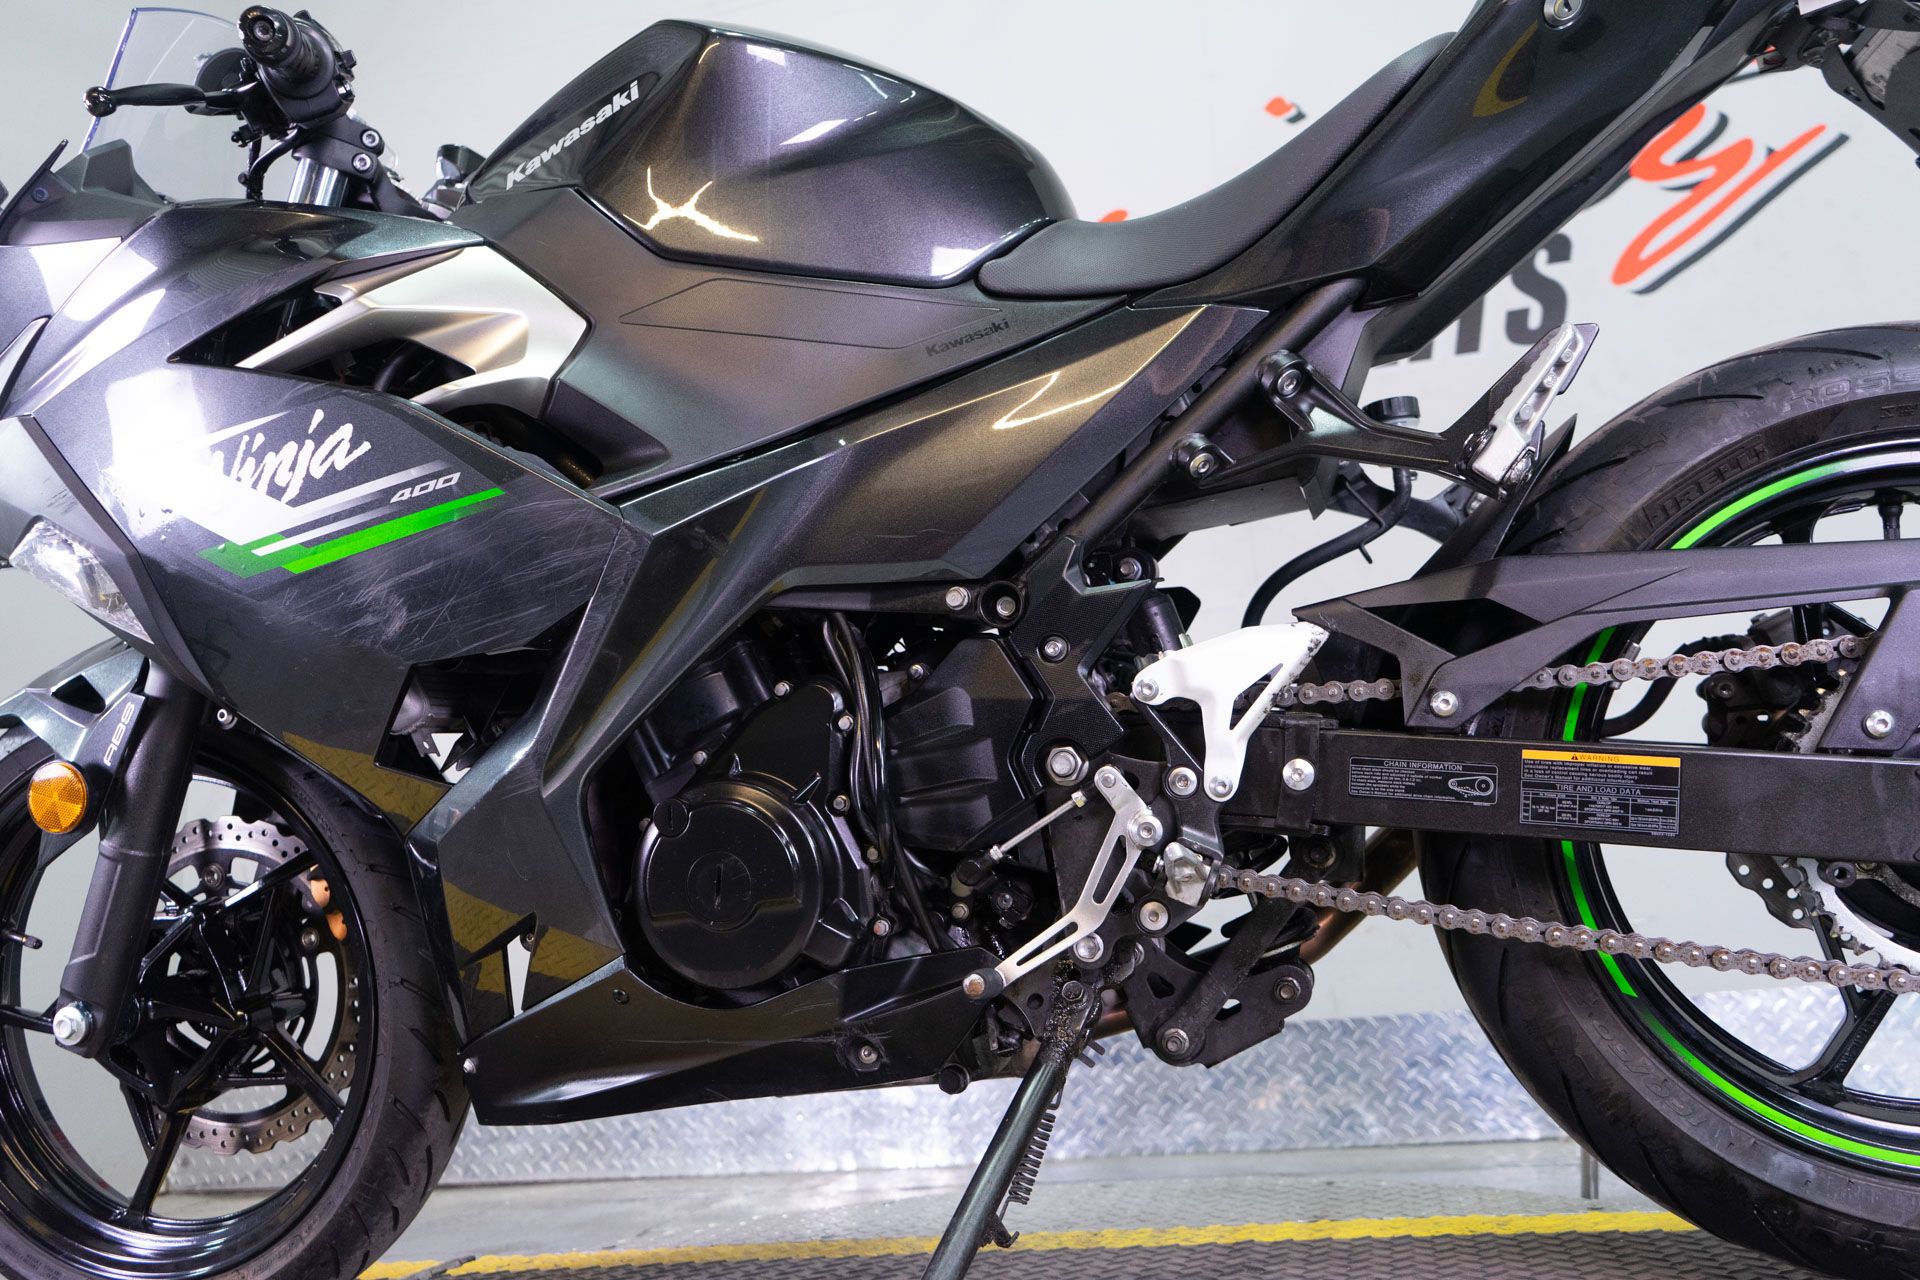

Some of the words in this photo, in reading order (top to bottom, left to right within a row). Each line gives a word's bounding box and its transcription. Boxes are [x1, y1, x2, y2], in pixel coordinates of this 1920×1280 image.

[505, 80, 640, 191] Kawasaki
[925, 318, 1010, 357] Kawasaki
[390, 471, 461, 504] 400
[103, 701, 135, 767] ABS
[1409, 762, 1462, 770] INFORMATION
[1580, 754, 1619, 762] WARNING
